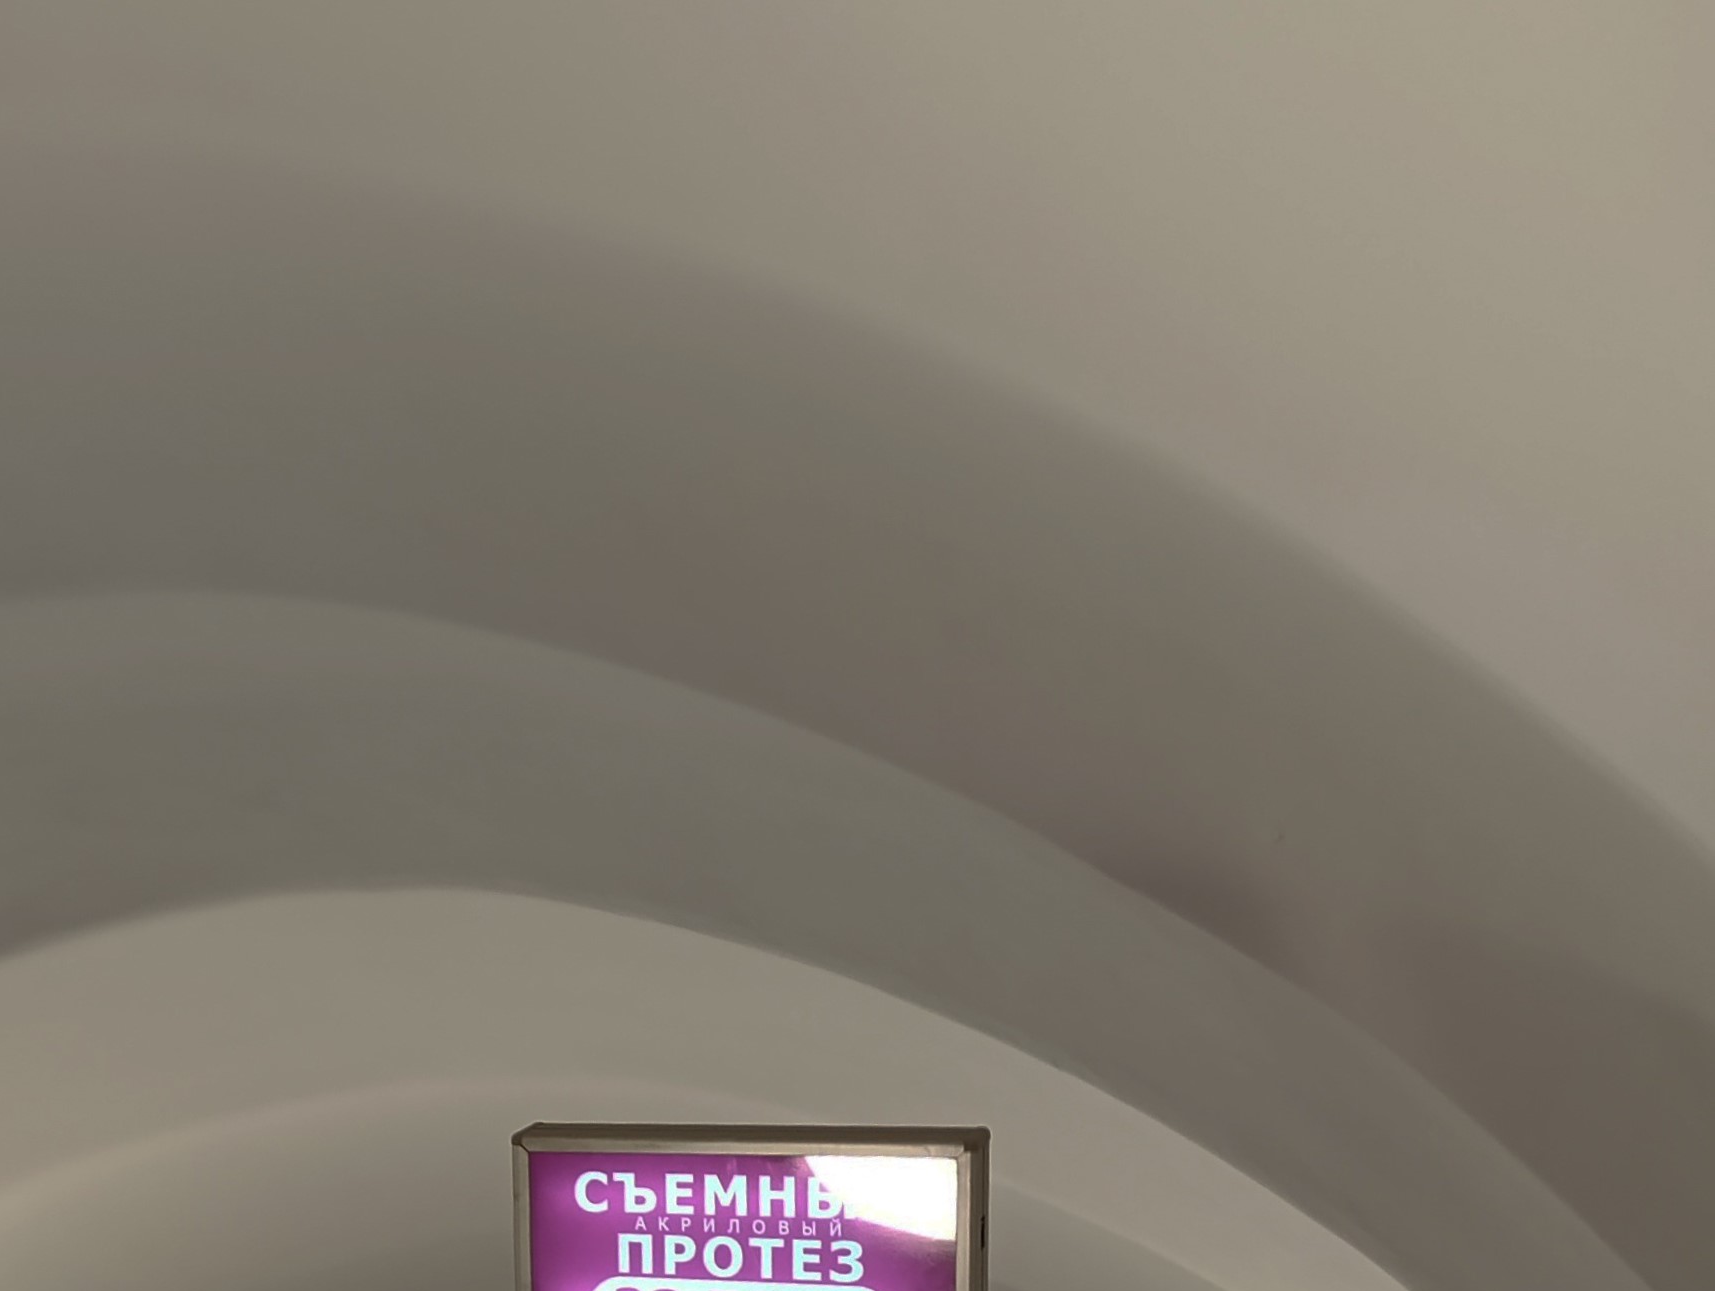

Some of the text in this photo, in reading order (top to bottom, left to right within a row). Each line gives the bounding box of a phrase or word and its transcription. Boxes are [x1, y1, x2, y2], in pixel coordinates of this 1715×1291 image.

[574, 1171, 857, 1220] СЪЕМНЫ
[634, 1216, 842, 1237] АКРИЛОВЫЙ
[617, 1233, 864, 1283] ПРОТЕЗ
